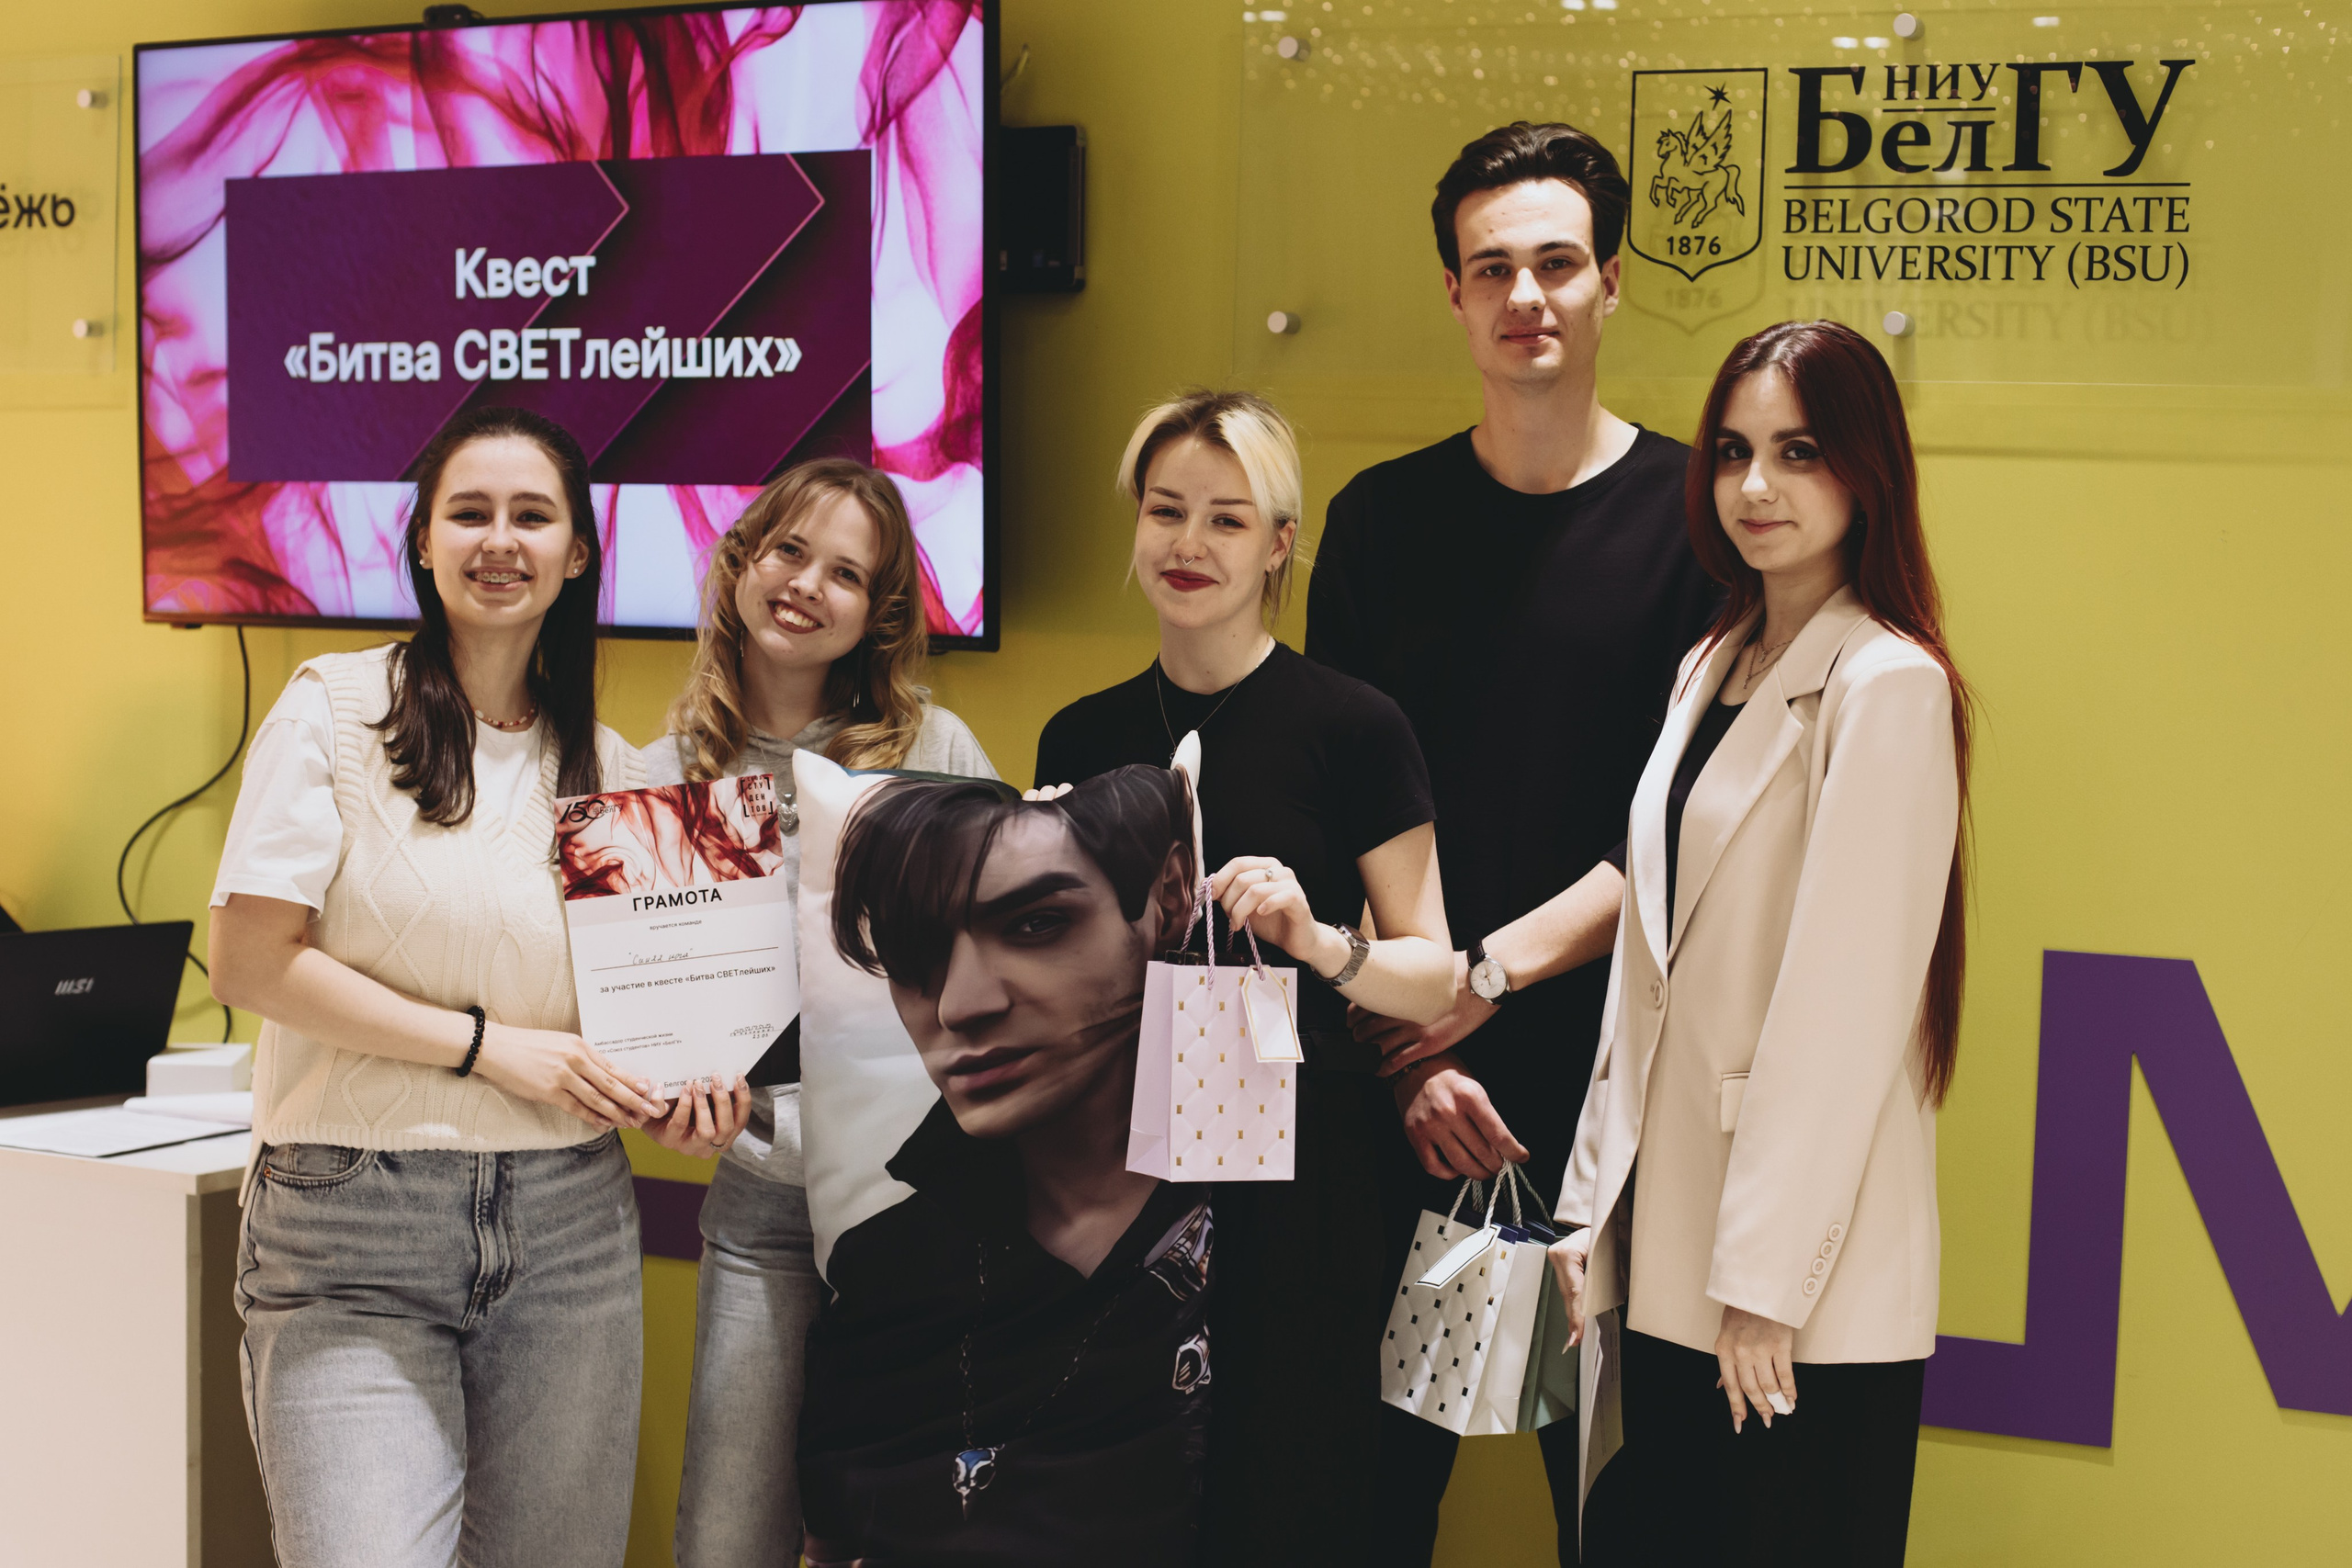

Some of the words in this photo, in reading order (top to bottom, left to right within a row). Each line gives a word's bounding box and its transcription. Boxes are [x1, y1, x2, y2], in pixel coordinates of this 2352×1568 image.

[1883, 62, 2001, 101] НИУ
[1784, 59, 2196, 177] БелГУ
[1782, 197, 2035, 233] BELGOROD
[2050, 197, 2191, 233] STATE
[1667, 235, 1722, 255] 1876
[455, 247, 596, 299] Квест
[1781, 245, 2055, 281] UNIVERSITY
[2067, 242, 2189, 289] (BSU)
[283, 332, 441, 382] «Битва
[453, 326, 803, 380] СВЕТлейших»
[748, 782, 763, 790] СТУ
[749, 794, 765, 802] ДЕН
[632, 888, 722, 911] ГРАМОТА
[650, 922, 678, 931] вручается
[55, 978, 94, 996] MSI
[611, 981, 645, 993] участие
[654, 976, 684, 987] квесте
[685, 972, 715, 982] «Битва
[717, 965, 776, 978] СВЕТлейших»
